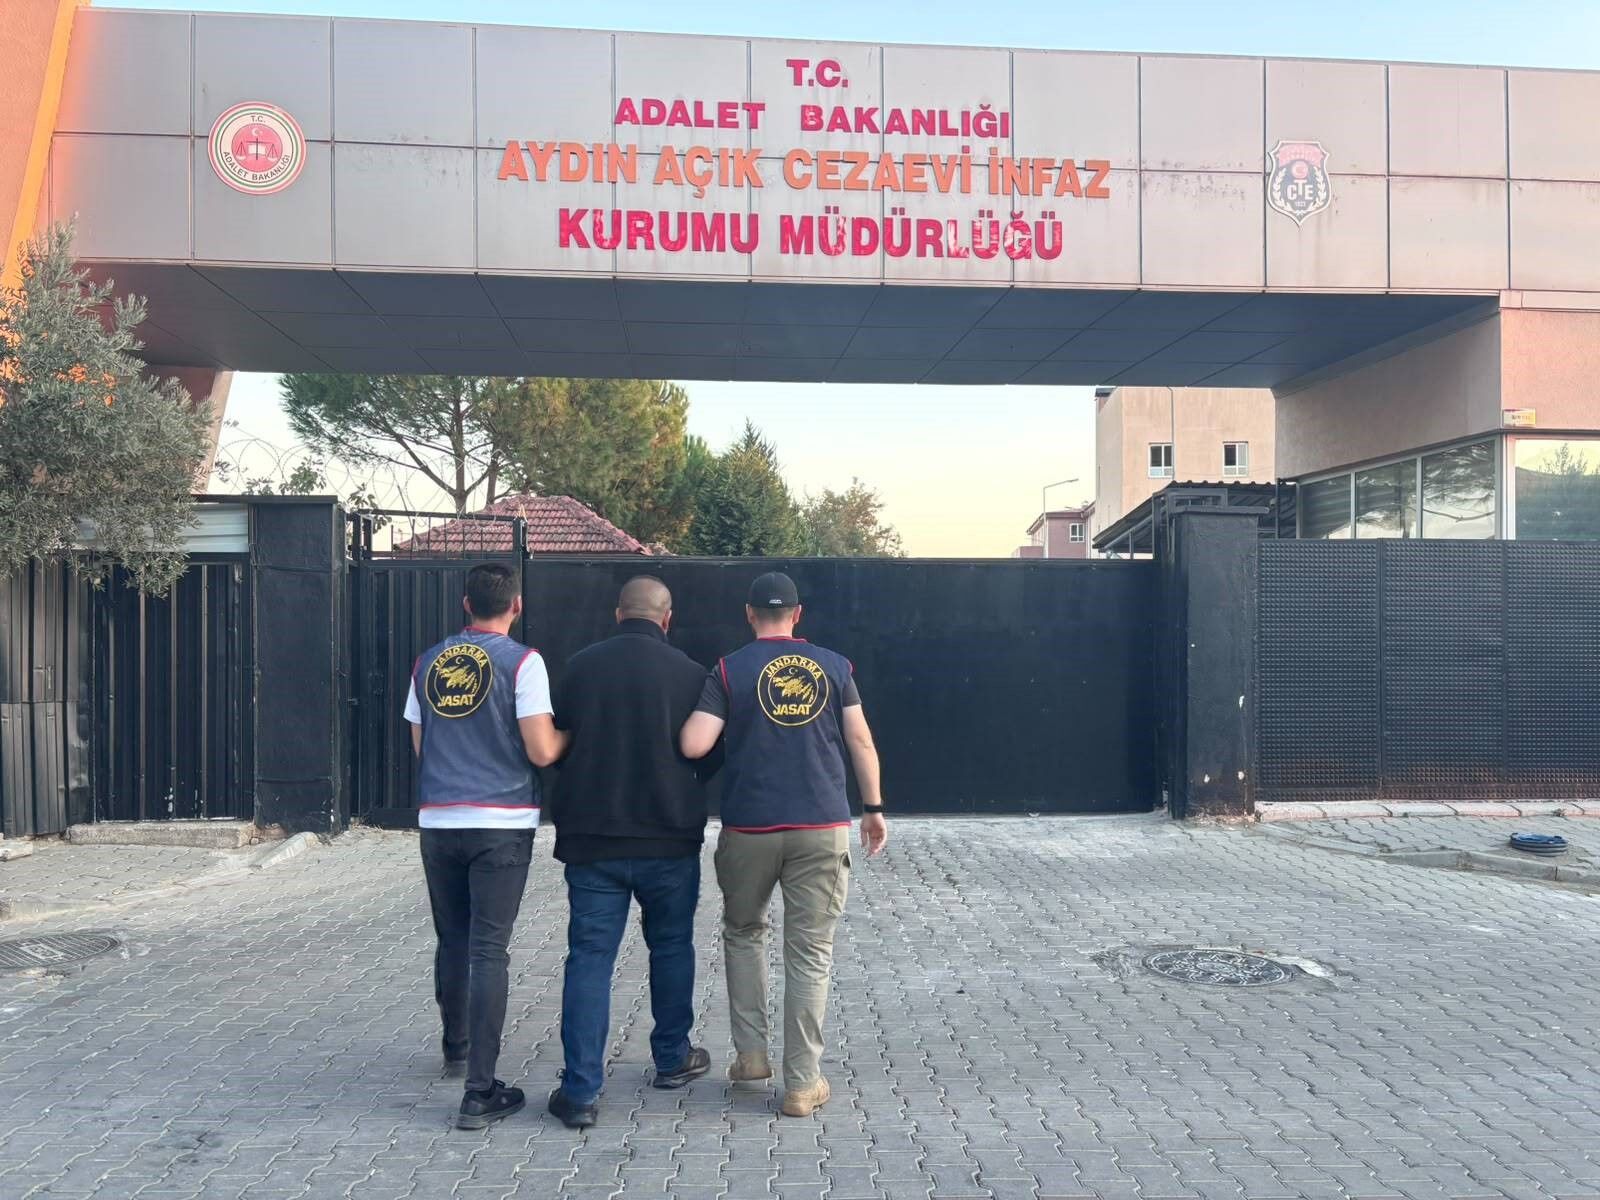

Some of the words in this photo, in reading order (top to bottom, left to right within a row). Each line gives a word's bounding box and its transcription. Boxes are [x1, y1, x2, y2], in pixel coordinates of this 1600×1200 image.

[786, 59, 848, 87] T.C.
[251, 115, 266, 123] T.C.
[614, 97, 766, 129] ADALET
[800, 103, 1010, 138] BAKANLIĞI
[223, 151, 249, 178] ADALET
[497, 140, 637, 184] AYDIN
[653, 145, 765, 199] AÇIK
[783, 145, 972, 195] CEZAEVİ
[988, 147, 1111, 199] İNFAZ
[558, 208, 760, 254] KURUMU
[779, 205, 1064, 260] MÜDÜRLÜĞÜ
[435, 646, 488, 671] JANDARMA
[765, 657, 822, 680] JANDARMA
[438, 694, 476, 707] JASAT
[773, 703, 812, 716] JASAT
